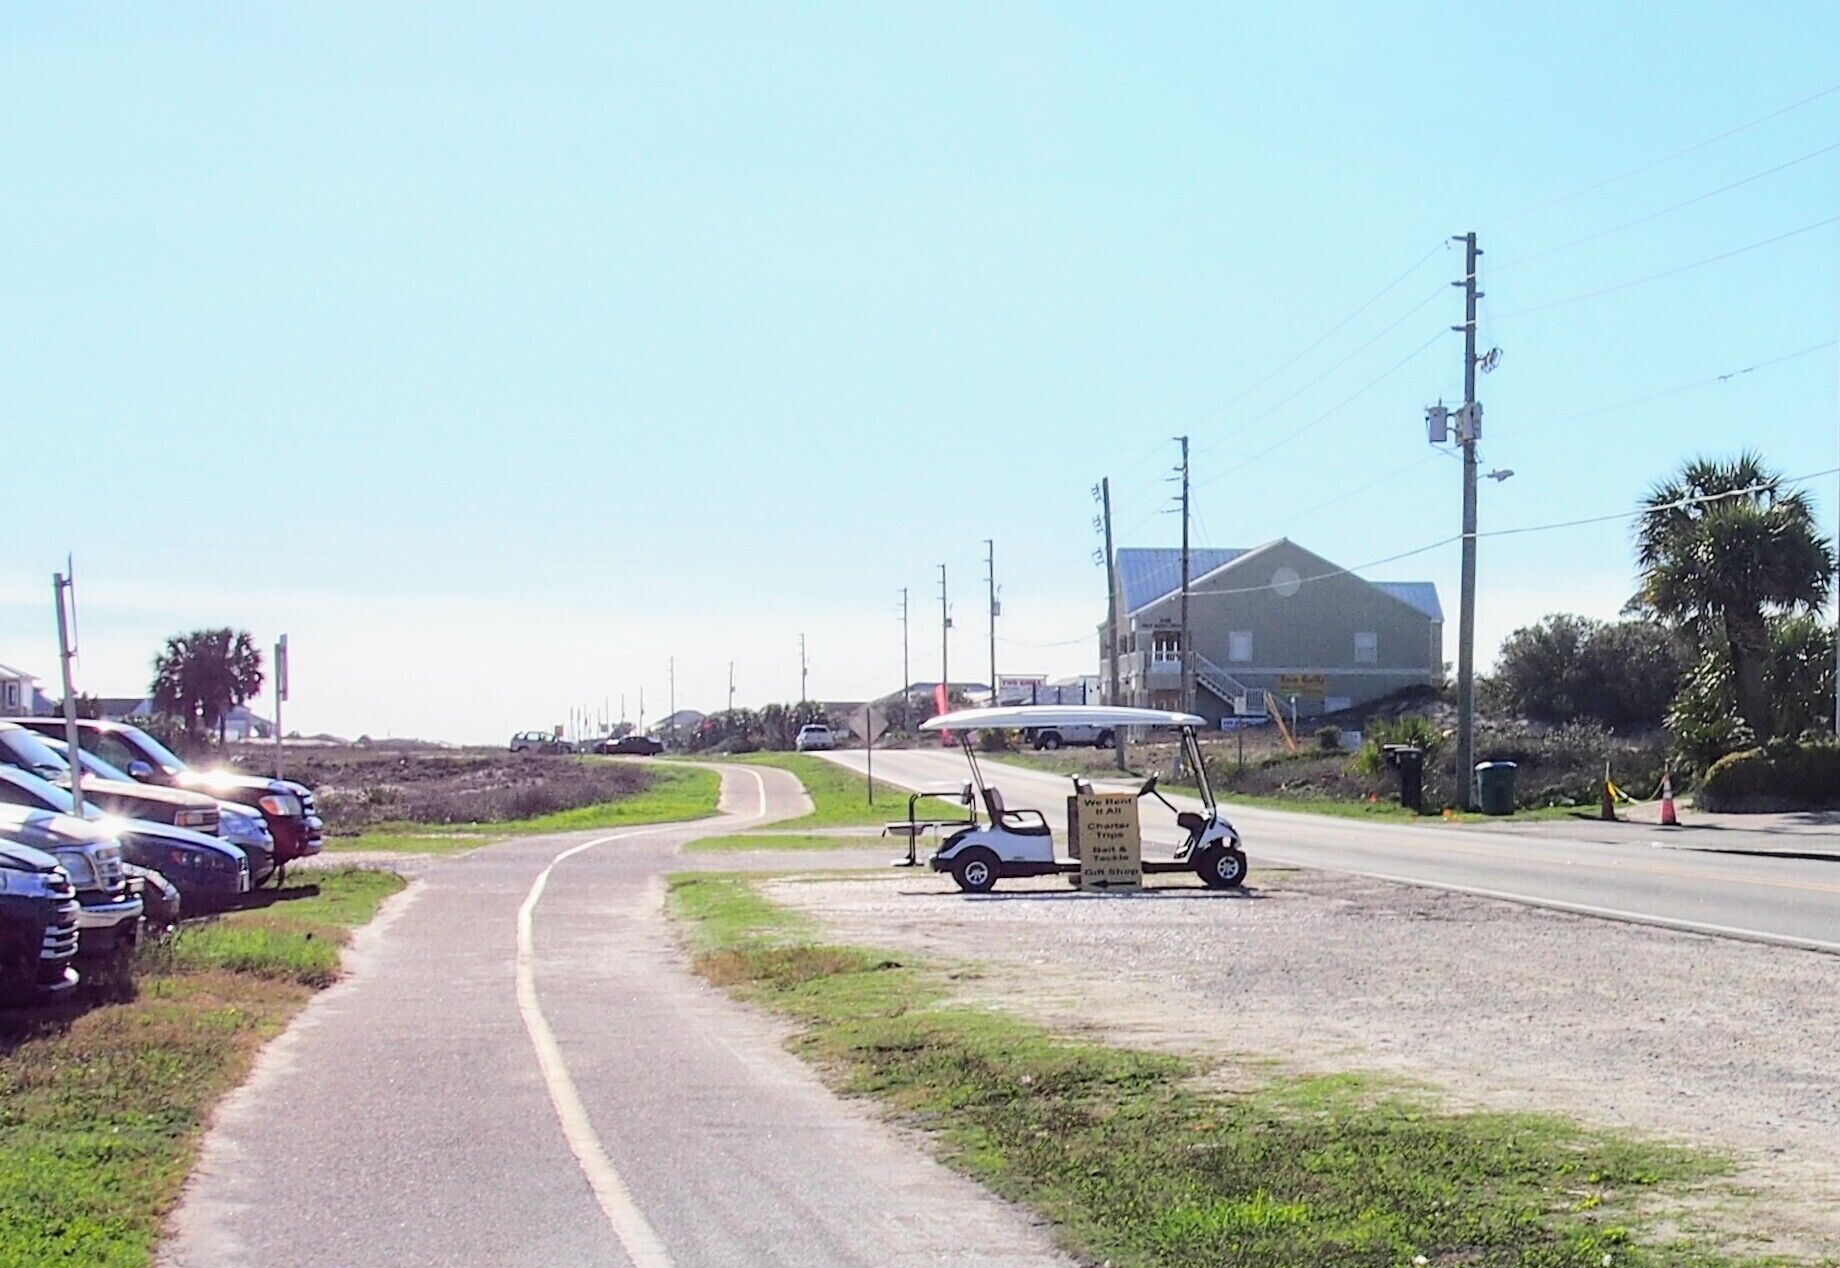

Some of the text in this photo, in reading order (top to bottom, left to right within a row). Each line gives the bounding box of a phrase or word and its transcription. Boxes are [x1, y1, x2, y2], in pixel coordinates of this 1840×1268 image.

[1106, 807, 1122, 815] All
[1087, 822, 1130, 830] Charter
[1097, 832, 1124, 840] Trips
[1084, 868, 1139, 876] Gift Shop
